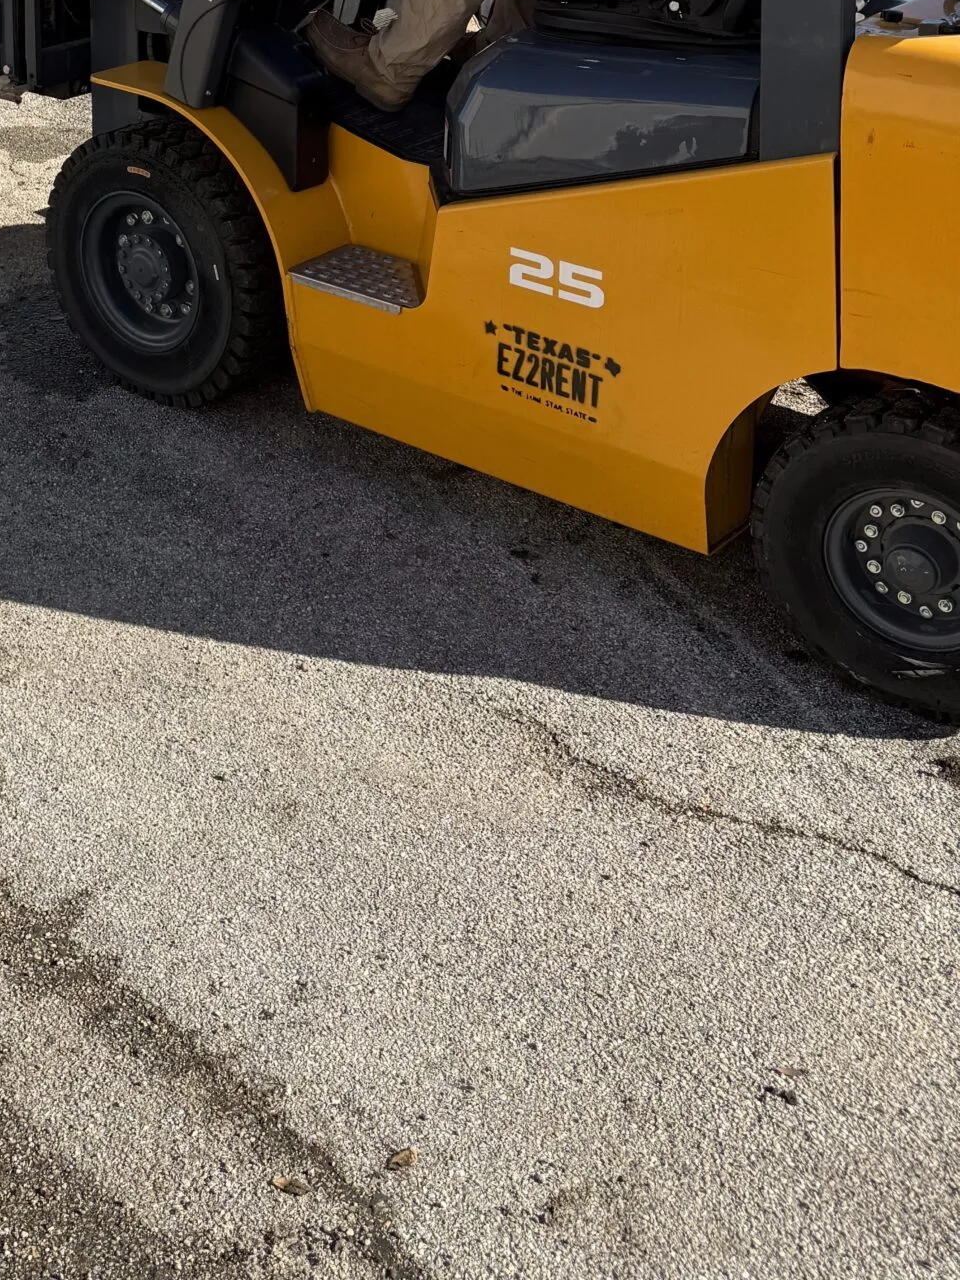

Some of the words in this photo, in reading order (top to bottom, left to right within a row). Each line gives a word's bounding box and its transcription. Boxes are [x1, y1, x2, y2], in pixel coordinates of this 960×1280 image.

[509, 246, 605, 309] 25
[512, 324, 591, 369] TEXAS
[496, 342, 603, 409] EZ2RENT
[511, 386, 523, 398] THE
[545, 400, 563, 413] STAR
[565, 407, 587, 421] STATE
